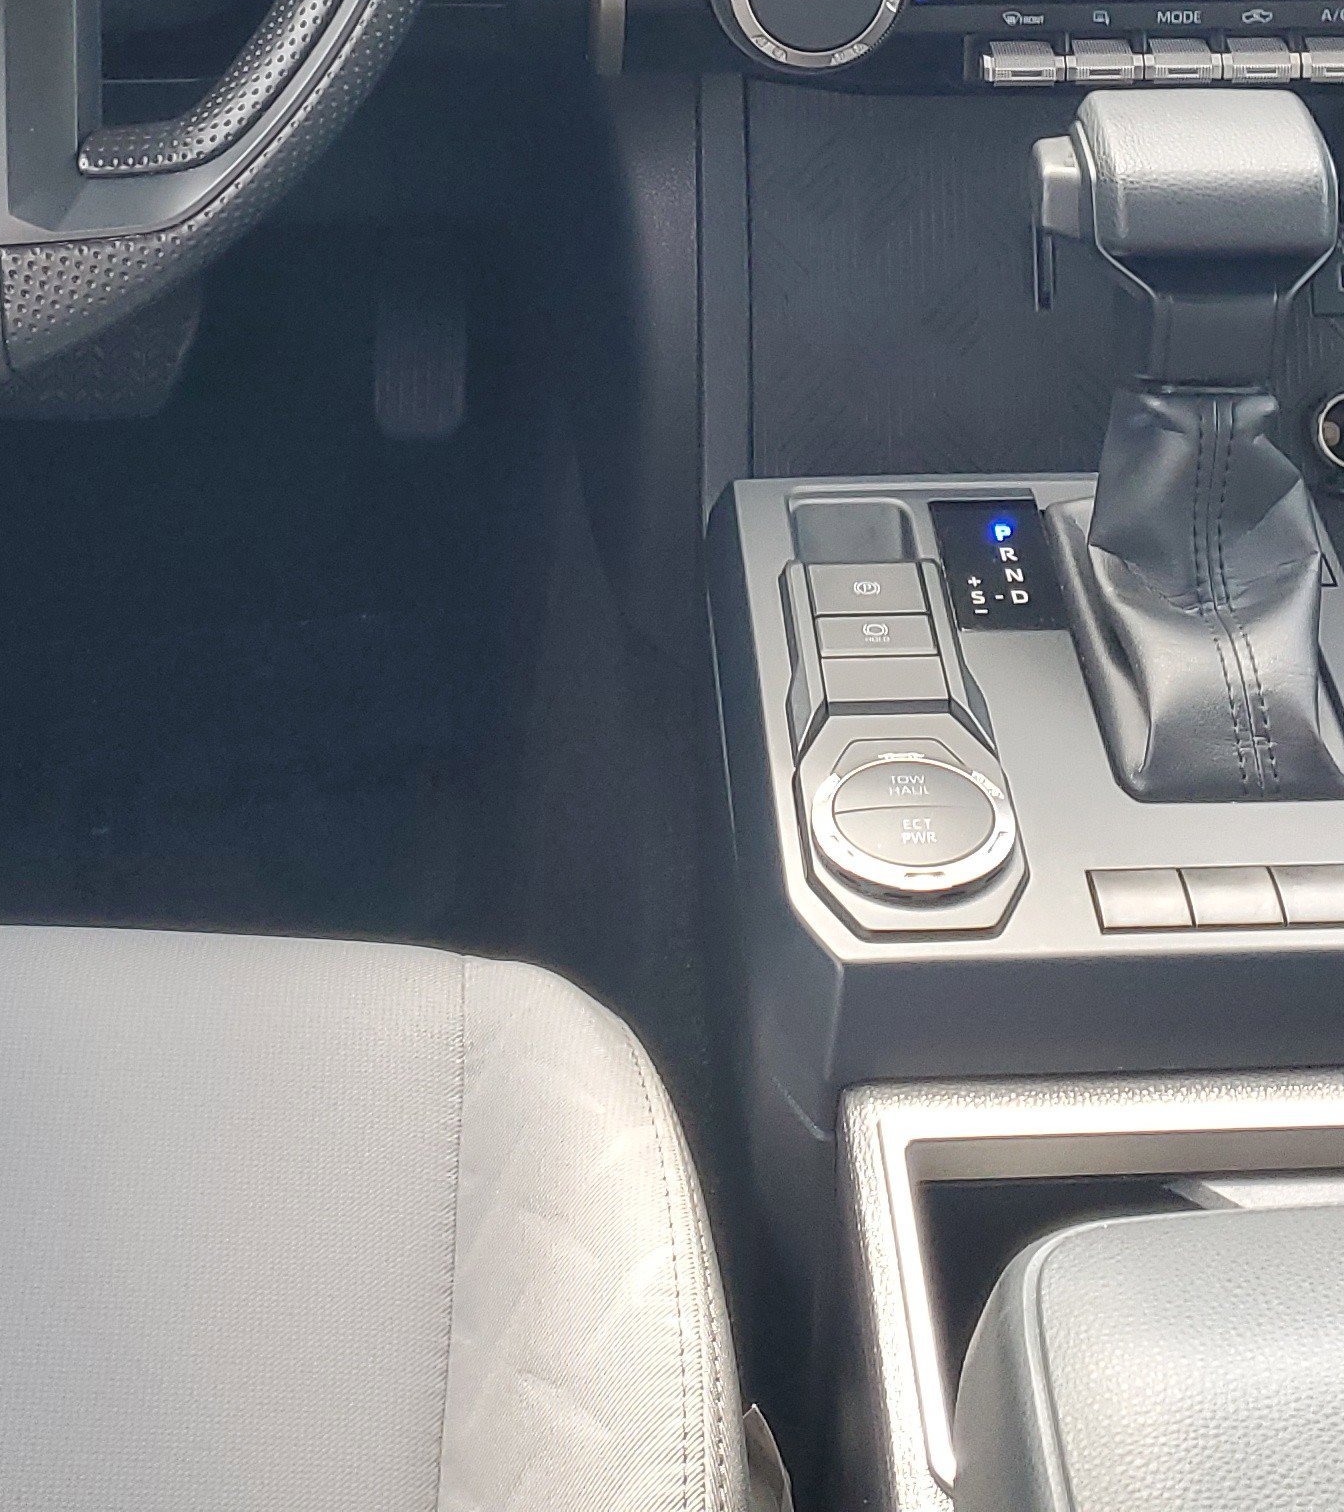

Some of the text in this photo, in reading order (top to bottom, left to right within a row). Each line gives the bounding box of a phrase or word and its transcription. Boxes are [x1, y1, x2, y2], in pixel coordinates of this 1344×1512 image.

[1157, 9, 1202, 24] MODE
[994, 524, 1012, 542] P
[999, 547, 1018, 562] R
[1004, 568, 1024, 583] N
[1010, 590, 1029, 604] D
[891, 774, 926, 785] TOW
[889, 785, 930, 796] HAUL
[902, 818, 932, 830] ECT
[901, 831, 938, 845] PWR
